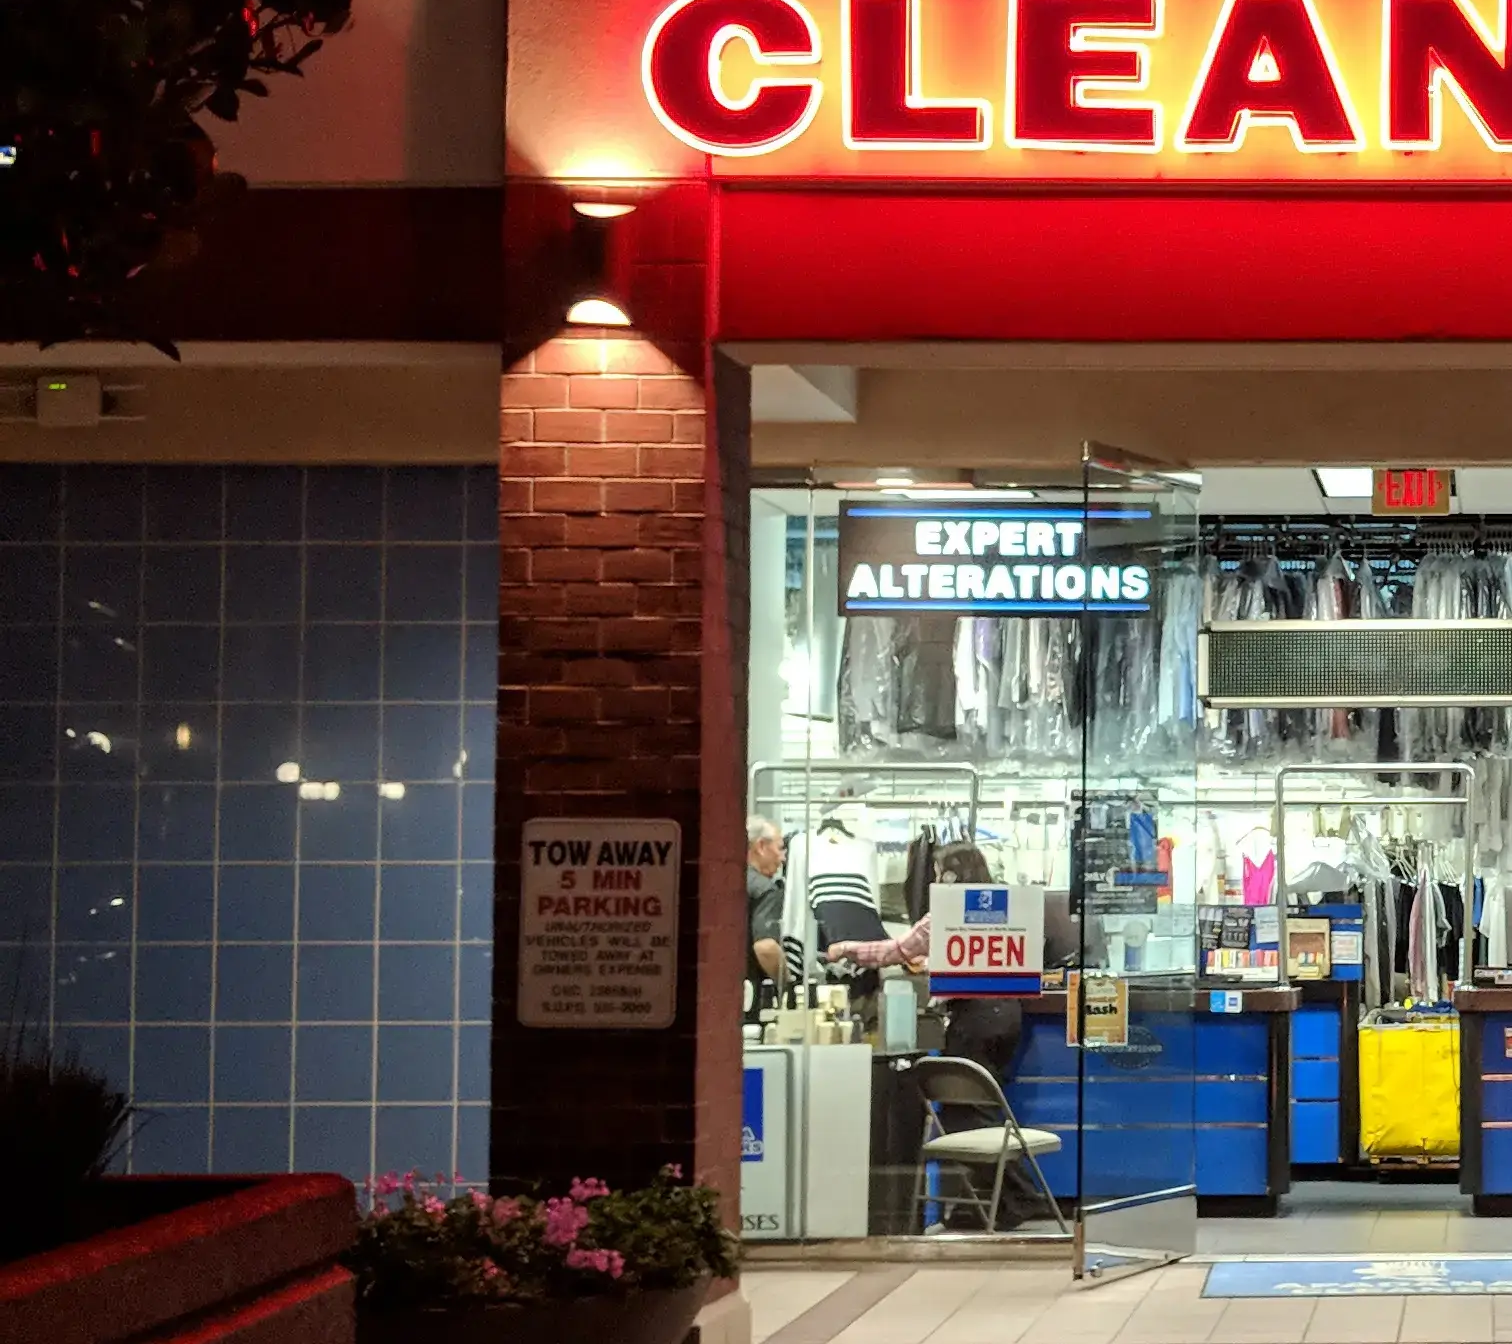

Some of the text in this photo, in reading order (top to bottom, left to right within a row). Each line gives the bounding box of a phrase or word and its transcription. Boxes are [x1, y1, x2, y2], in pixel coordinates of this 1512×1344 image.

[1386, 470, 1435, 507] EXIT
[915, 520, 1084, 556] EXPERT
[847, 563, 1150, 600] ALTERATIONS
[528, 840, 673, 866] TOW AWAY
[560, 870, 643, 890] 5 MIN
[537, 895, 663, 917] PARKING
[526, 935, 598, 947] VEHICLES
[607, 935, 643, 947] WILL
[946, 934, 1025, 967] OPEN
